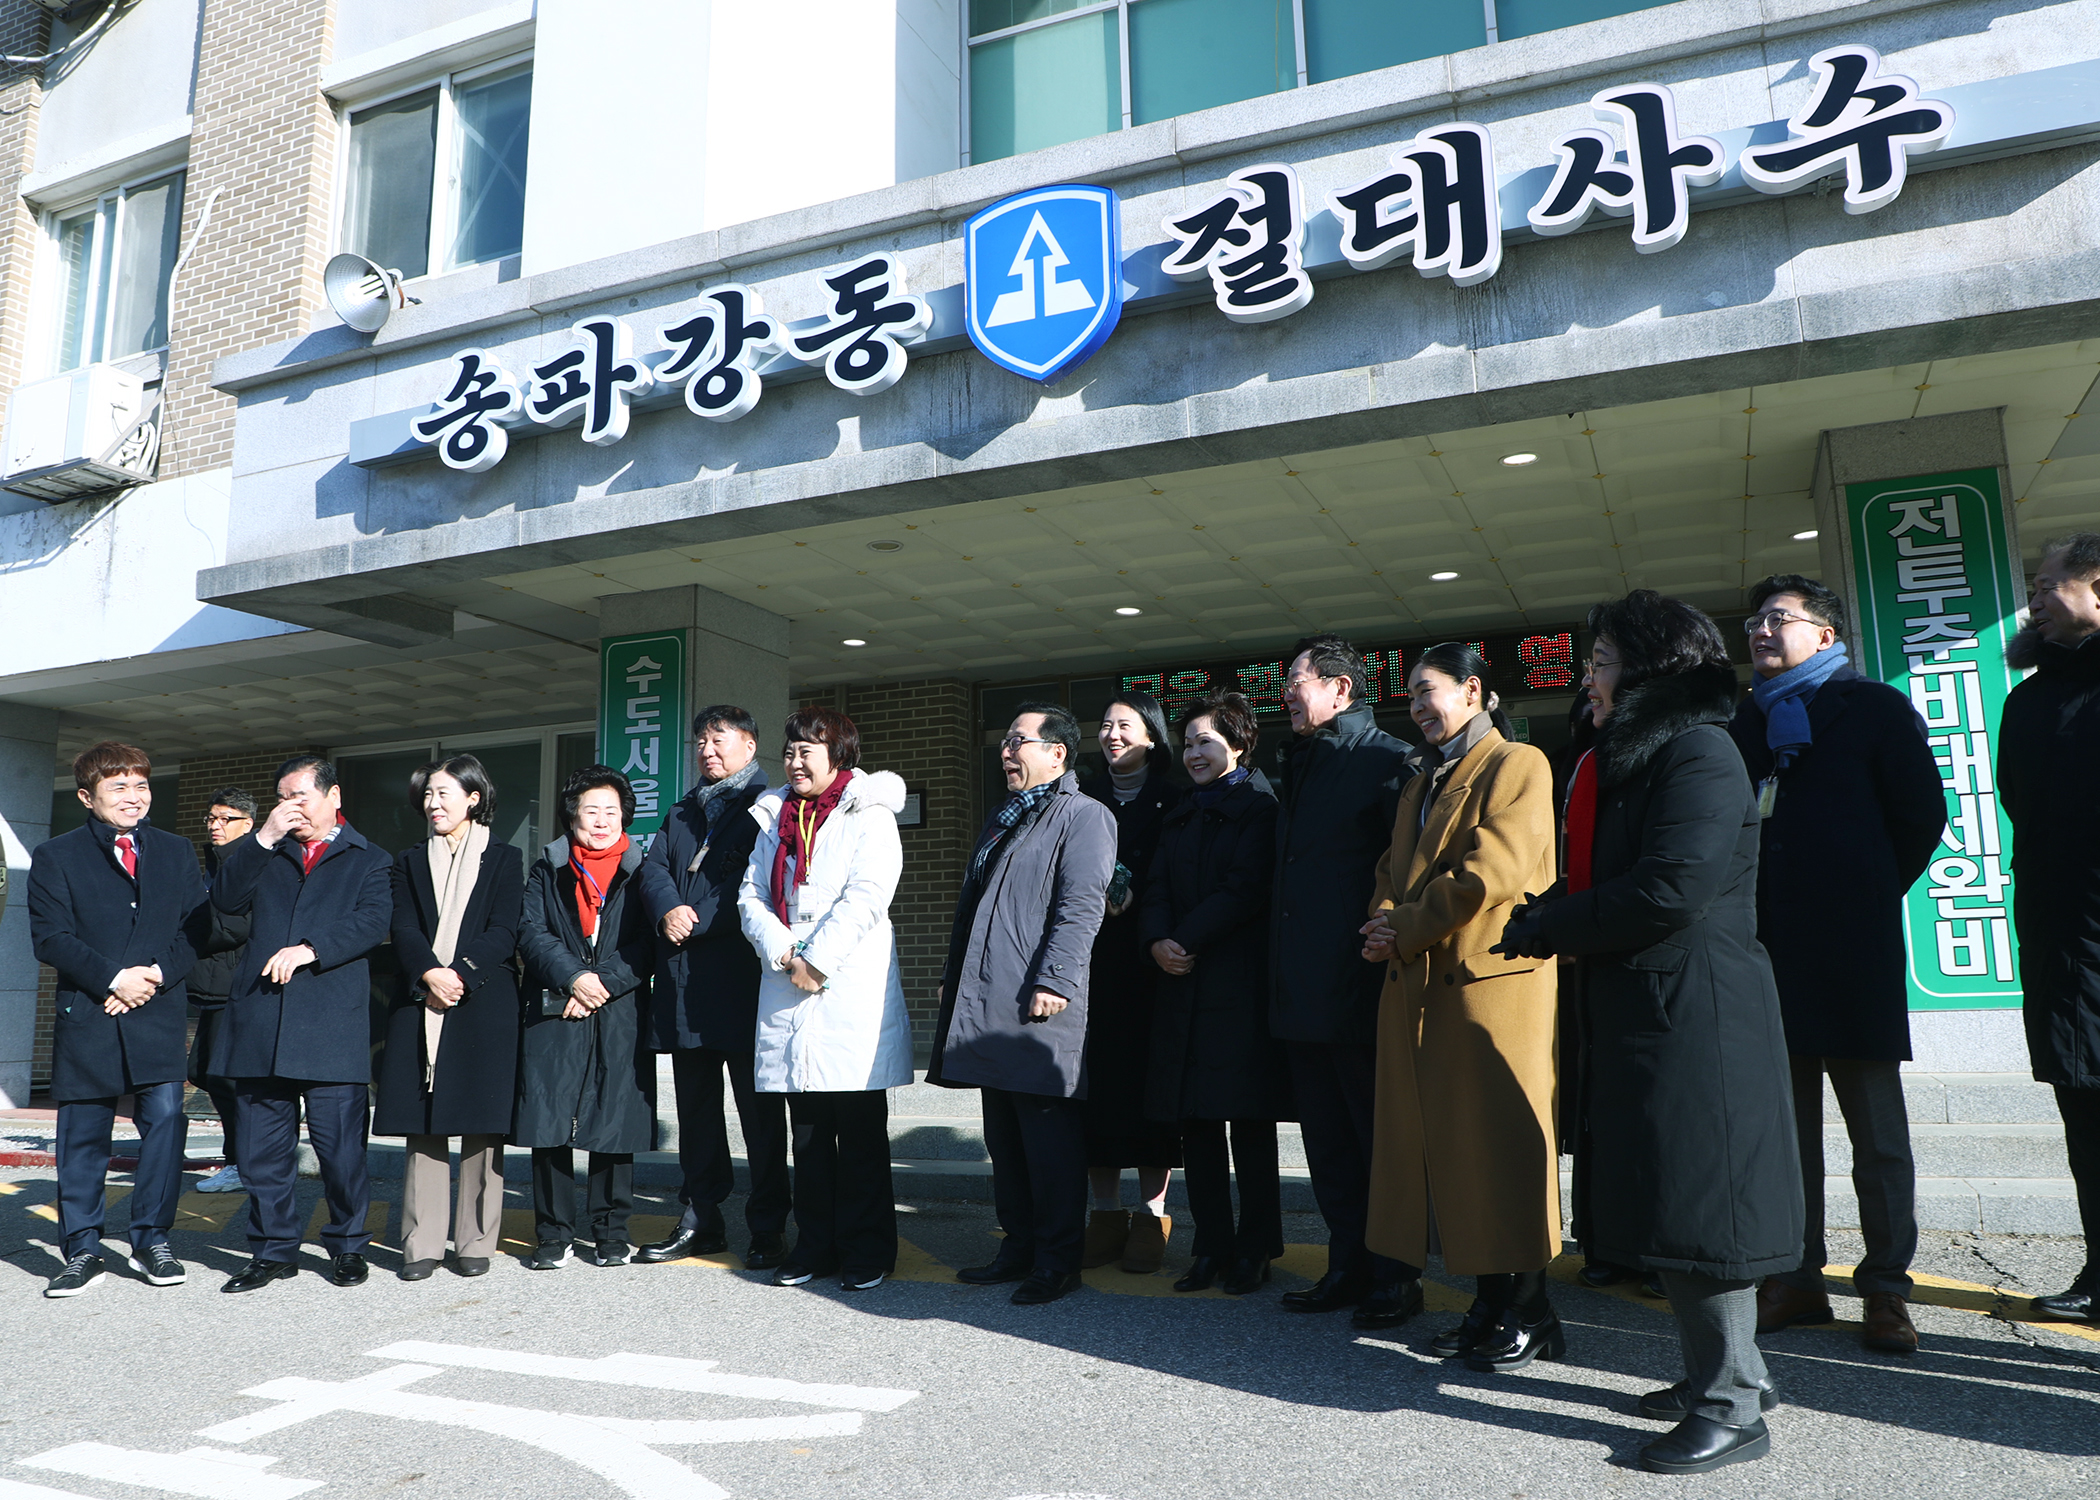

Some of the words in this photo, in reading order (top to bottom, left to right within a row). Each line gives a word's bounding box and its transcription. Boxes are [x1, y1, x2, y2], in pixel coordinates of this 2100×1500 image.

[413, 254, 924, 466] 송파강동
[1168, 49, 1948, 314] 절대사수
[620, 655, 663, 819] 수도서울
